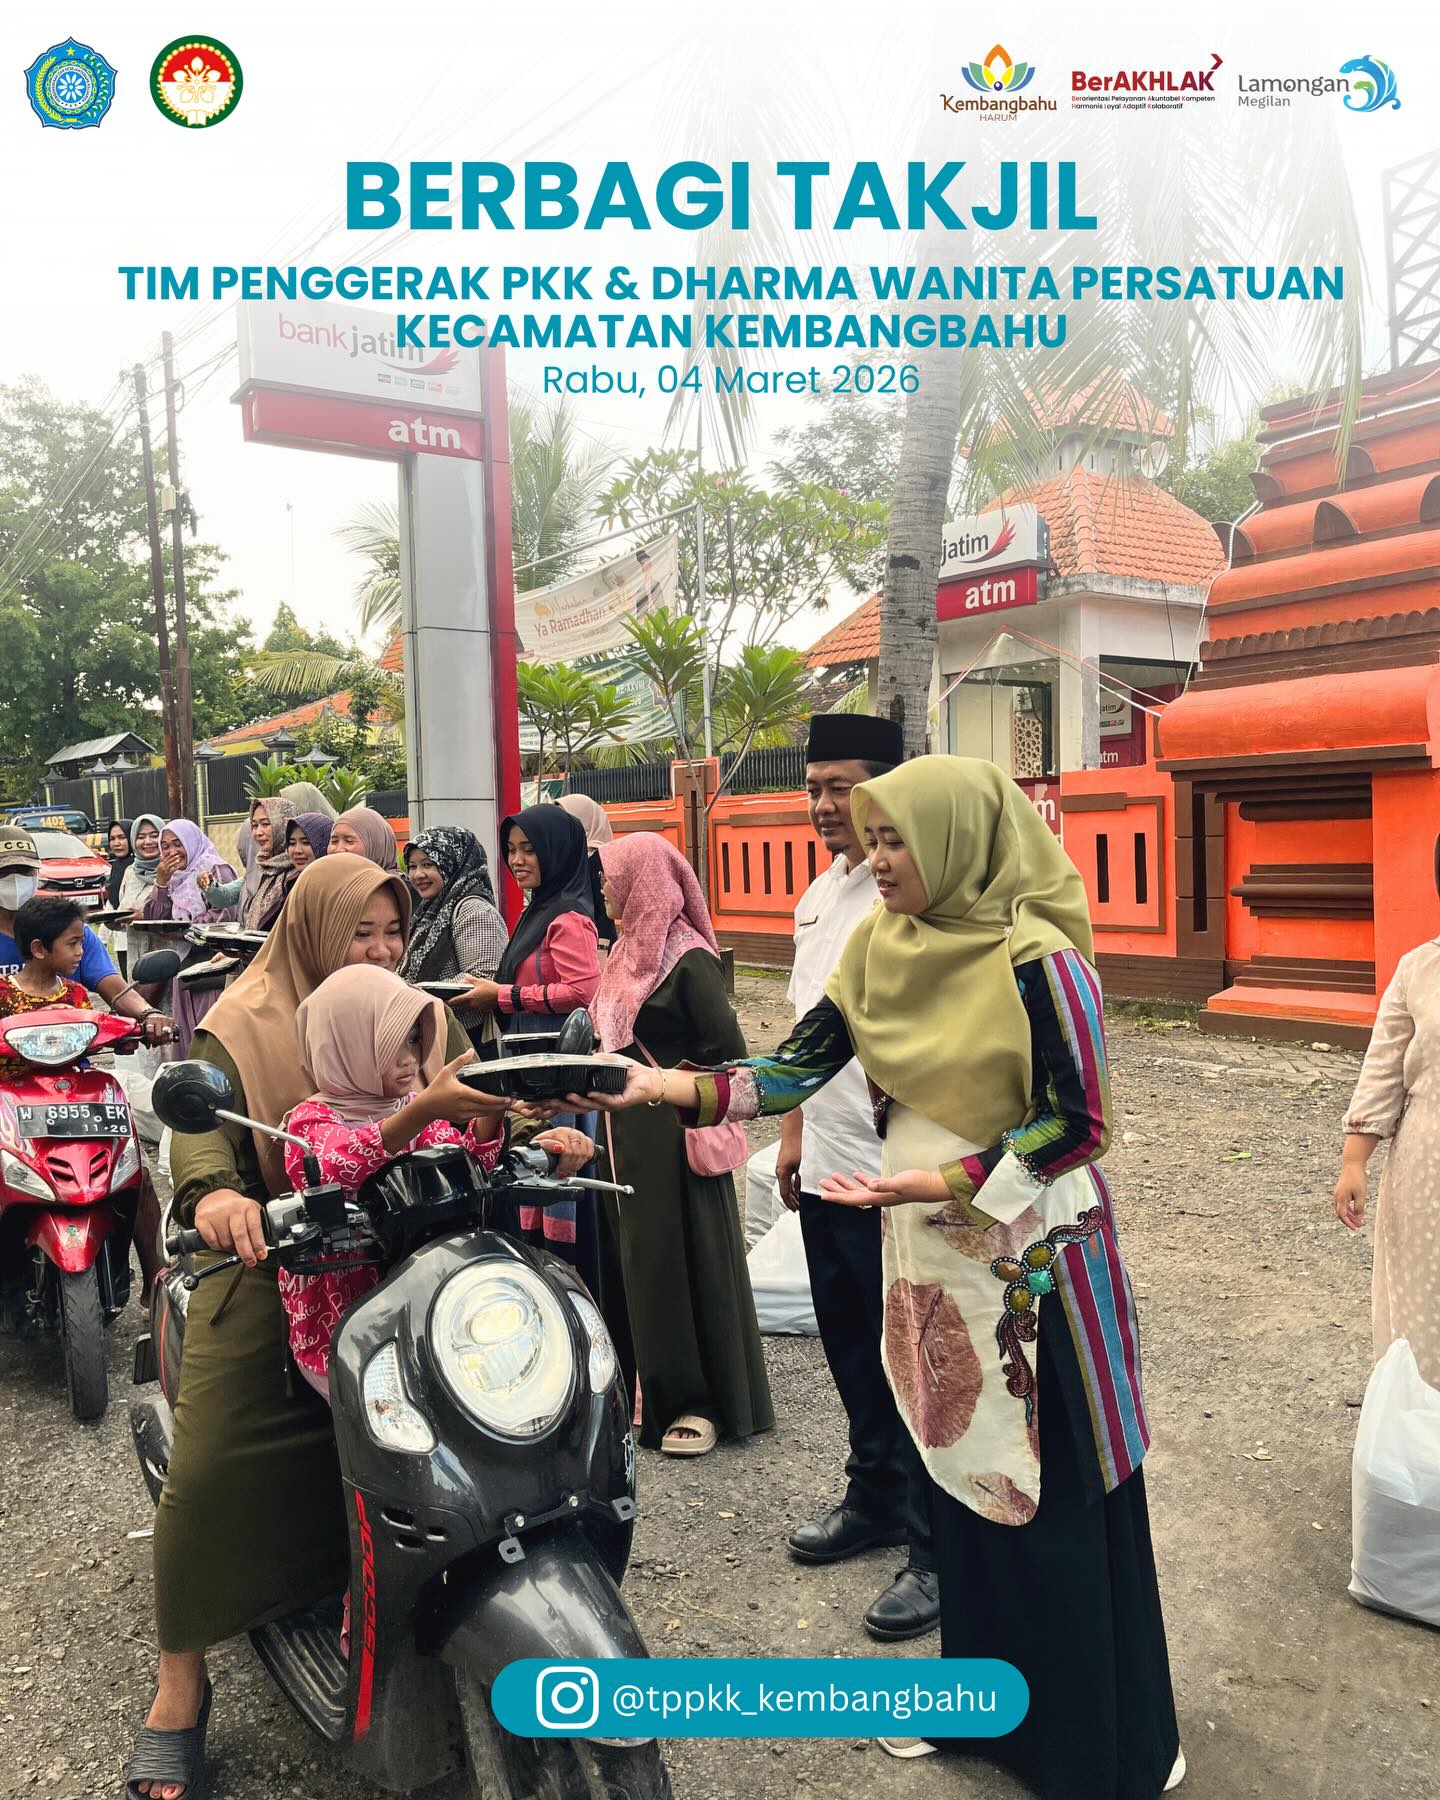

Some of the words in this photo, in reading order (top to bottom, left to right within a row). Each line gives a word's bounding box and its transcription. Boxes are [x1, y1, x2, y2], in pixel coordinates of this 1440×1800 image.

[388, 416, 462, 450] atm
[941, 533, 989, 567] jatim
[965, 579, 1016, 609] atm
[534, 622, 549, 638] Ya
[549, 608, 607, 634] Ramadhan
[40, 815, 65, 828] 1402
[20, 1107, 33, 1120] W
[47, 1105, 91, 1120] 6955
[105, 1105, 127, 1120] EK
